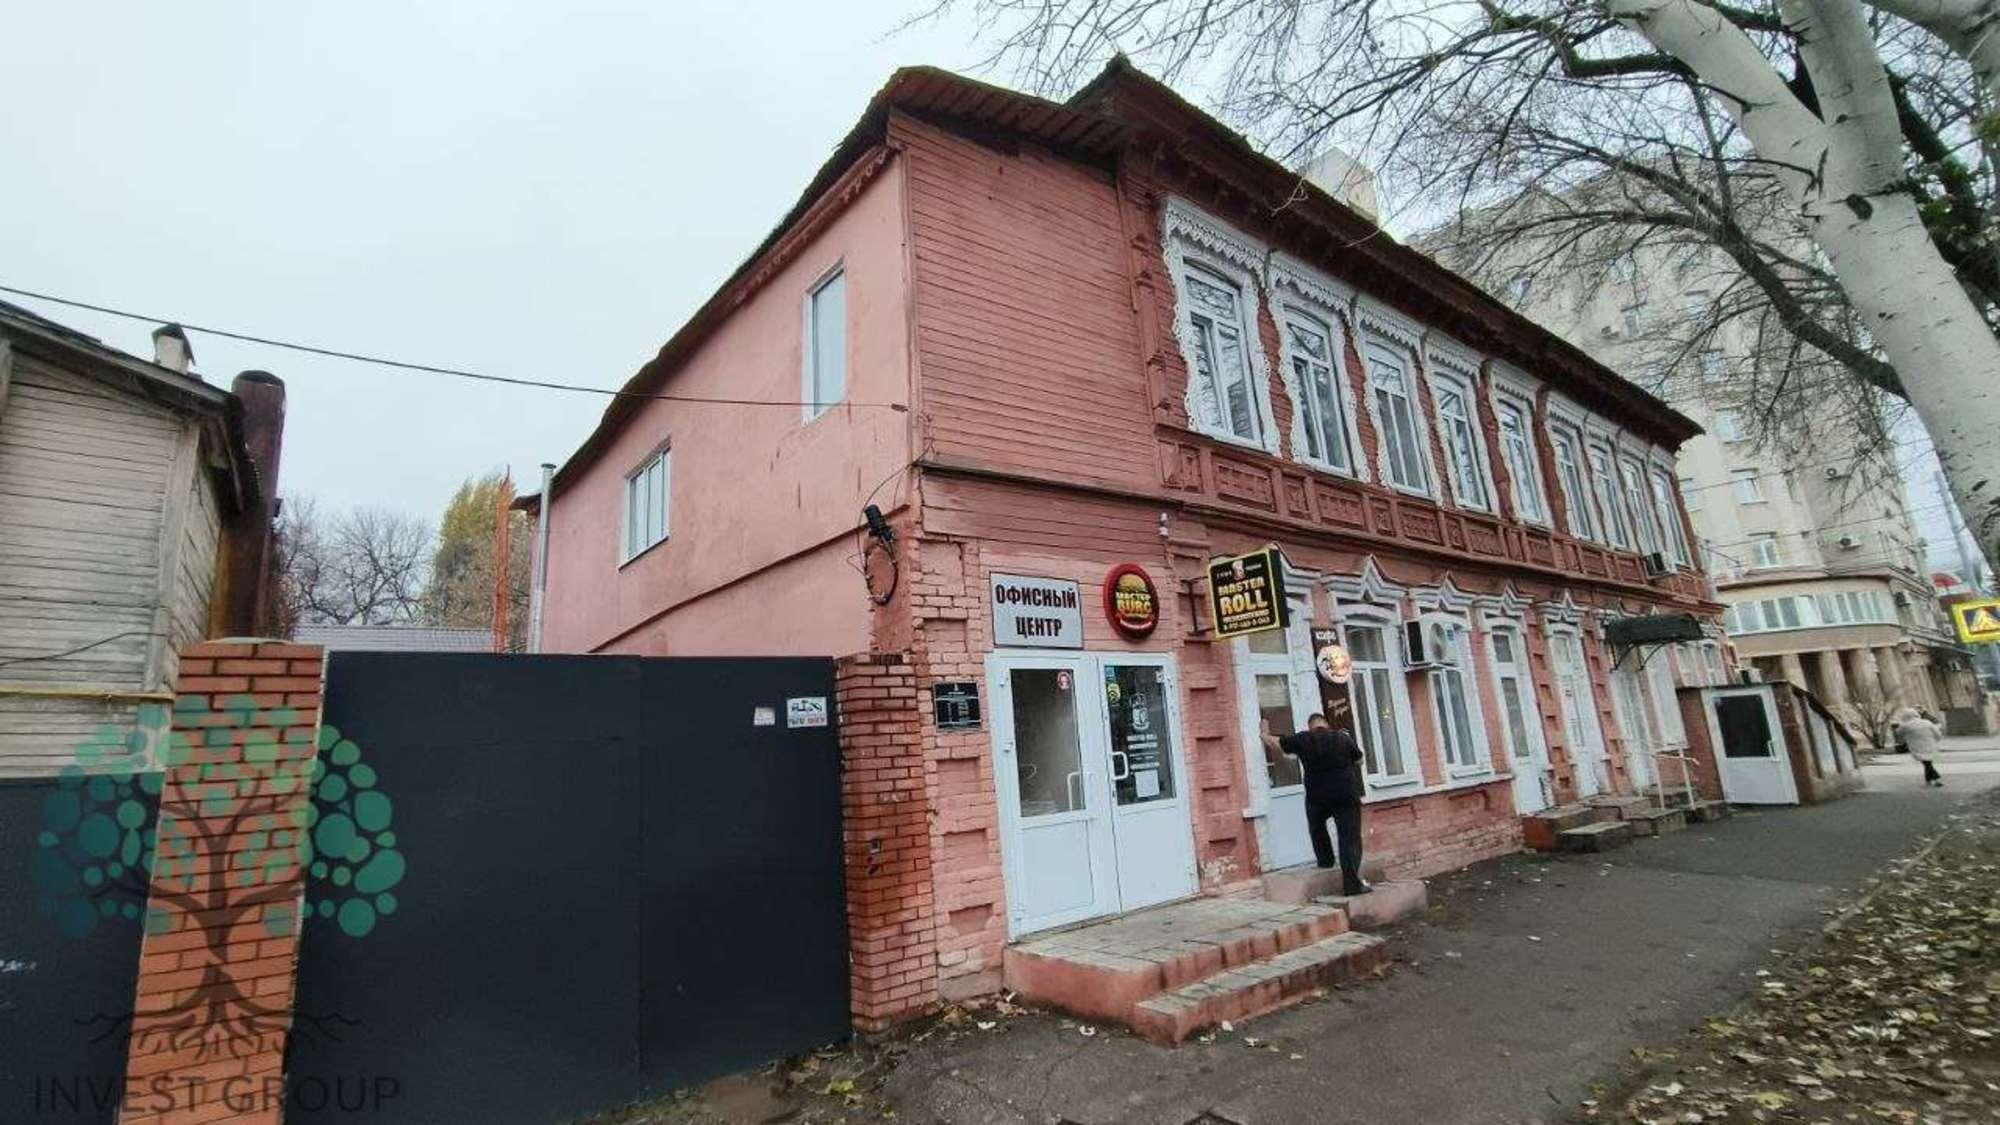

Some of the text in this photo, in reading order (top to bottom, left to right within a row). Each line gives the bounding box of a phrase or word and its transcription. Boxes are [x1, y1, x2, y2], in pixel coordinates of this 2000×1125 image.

[995, 584, 1076, 609] ОФИСНЫЙ
[1220, 589, 1268, 616] ROLL
[1015, 616, 1062, 638] ЦЕНТР
